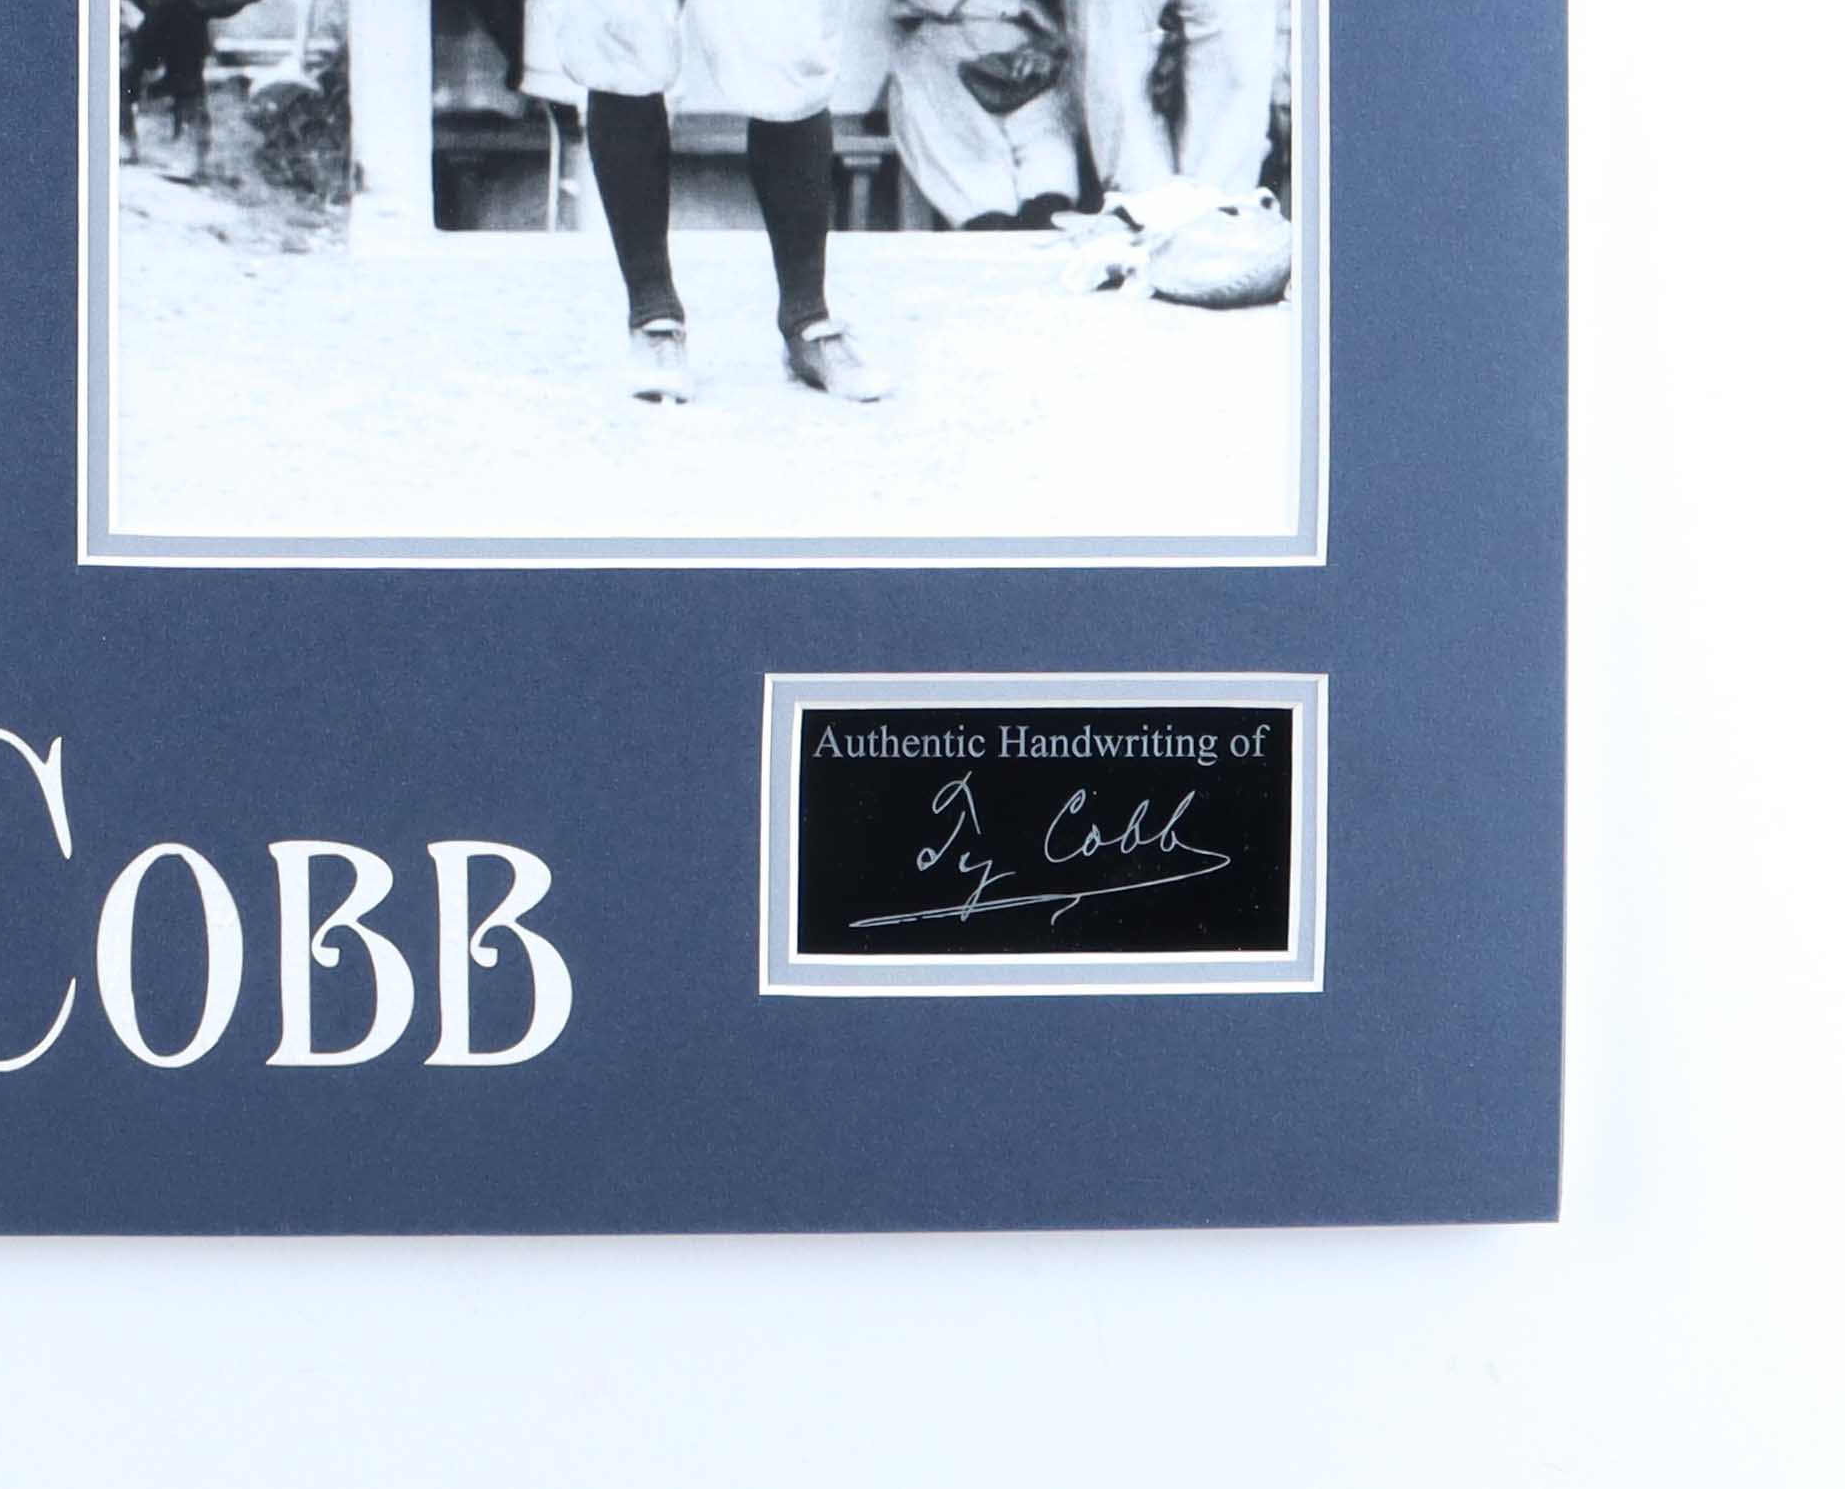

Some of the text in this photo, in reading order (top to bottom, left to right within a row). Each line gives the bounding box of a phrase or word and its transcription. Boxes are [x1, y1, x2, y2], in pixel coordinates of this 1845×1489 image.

[812, 723, 1272, 768] Authentic Handwriting of
[916, 770, 1231, 922] Ty Cobb
